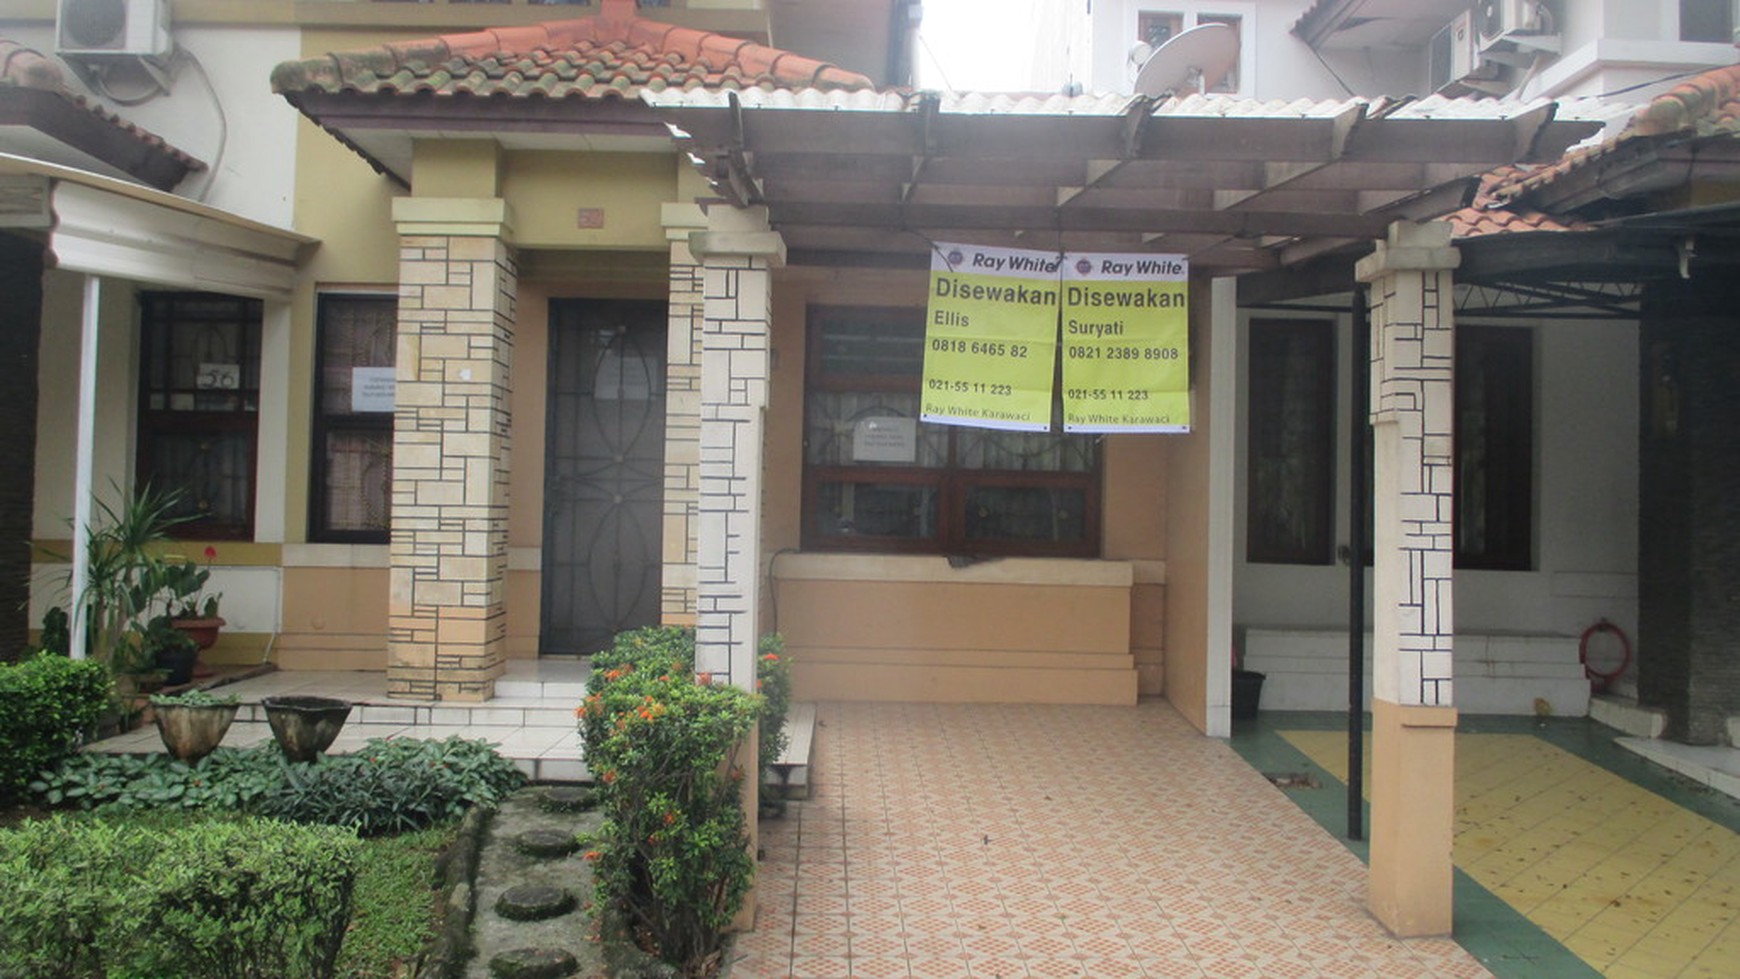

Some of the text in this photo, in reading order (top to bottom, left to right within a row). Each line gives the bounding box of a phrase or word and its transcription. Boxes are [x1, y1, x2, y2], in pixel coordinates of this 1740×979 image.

[972, 252, 1056, 273] Ray White
[1101, 260, 1182, 276] Ray White
[936, 278, 1056, 306] Disewakan
[1068, 287, 1185, 308] Disewakan
[934, 310, 969, 327] Ellis
[1068, 319, 1124, 338] Suryati
[932, 338, 1028, 358] 0818 6465 82
[1069, 346, 1178, 360] 0821 2389 8908
[928, 379, 1012, 396] 021-55 11 223
[1068, 389, 1149, 401] 021-55 11 223
[925, 403, 1031, 421] Ray White Karawaci
[1067, 413, 1170, 425] Ray White Karawaci
